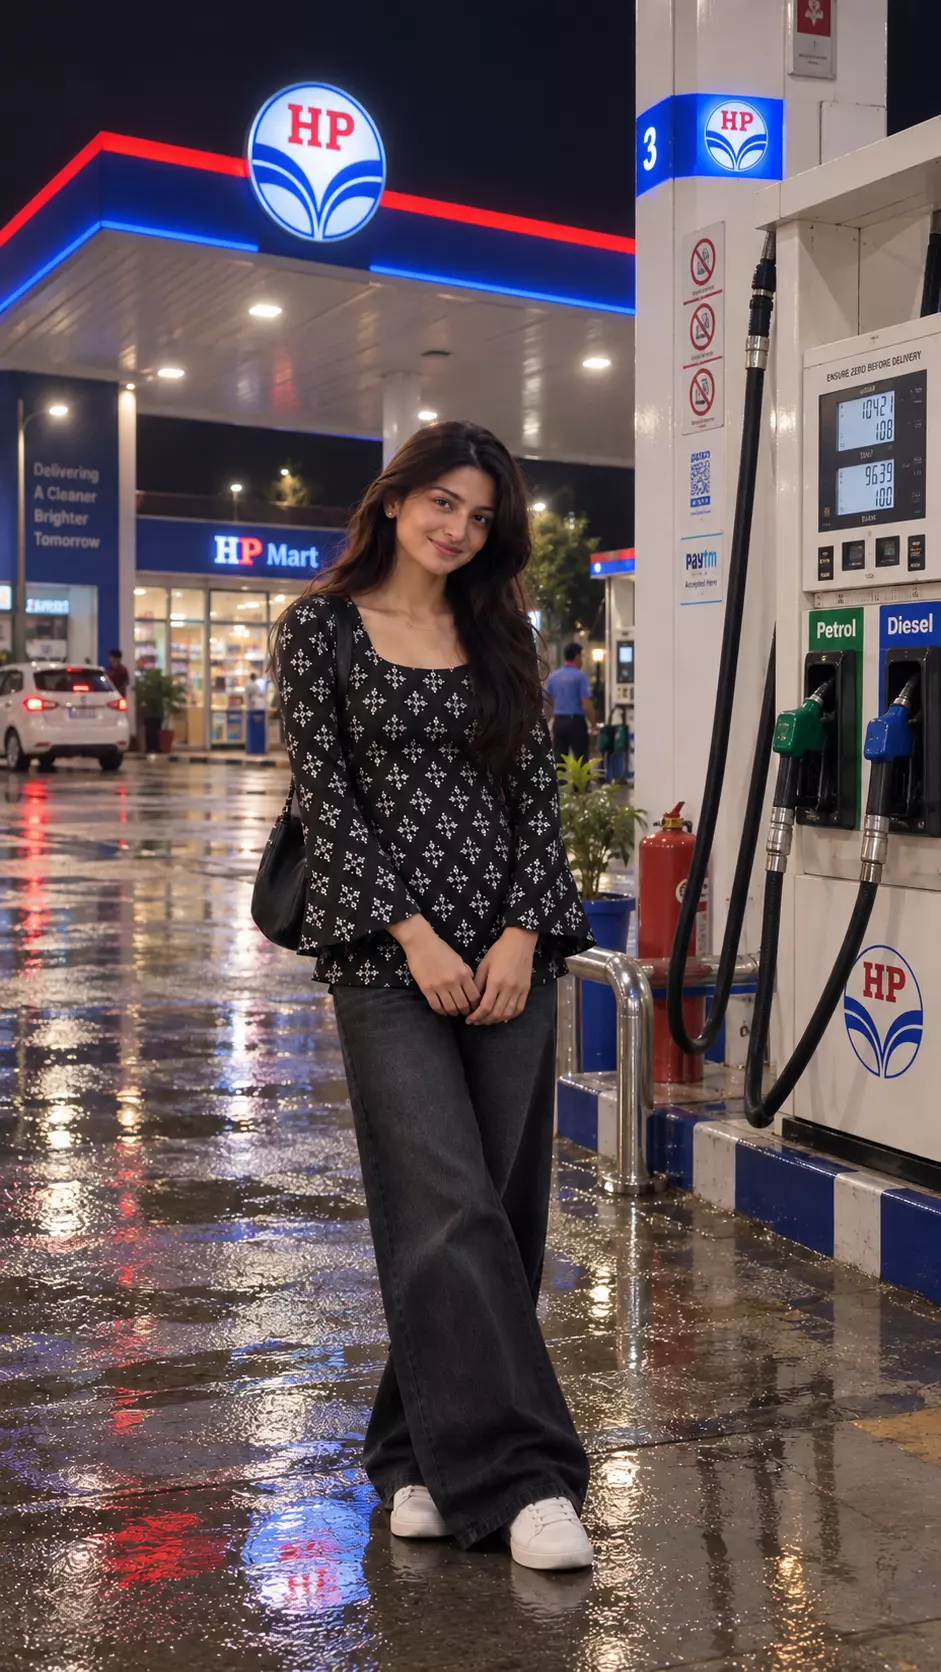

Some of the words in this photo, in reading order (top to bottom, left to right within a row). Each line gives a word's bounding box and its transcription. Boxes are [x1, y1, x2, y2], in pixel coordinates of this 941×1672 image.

[288, 103, 355, 151] HP
[720, 110, 754, 132] HP
[643, 126, 657, 171] 3
[826, 368, 849, 382] ENSURE
[867, 358, 891, 372] BEFORE
[892, 350, 922, 366] DELIVERY
[33, 462, 99, 484] Delivering
[33, 485, 44, 500] A
[47, 486, 97, 503] Cleaner
[34, 508, 89, 528] Brighter
[34, 531, 100, 549] Tomorrow
[214, 535, 263, 566] HP
[266, 543, 319, 569] Mart
[817, 619, 856, 639] Petrol
[887, 613, 933, 635] Diesel
[863, 961, 906, 1003] HP
